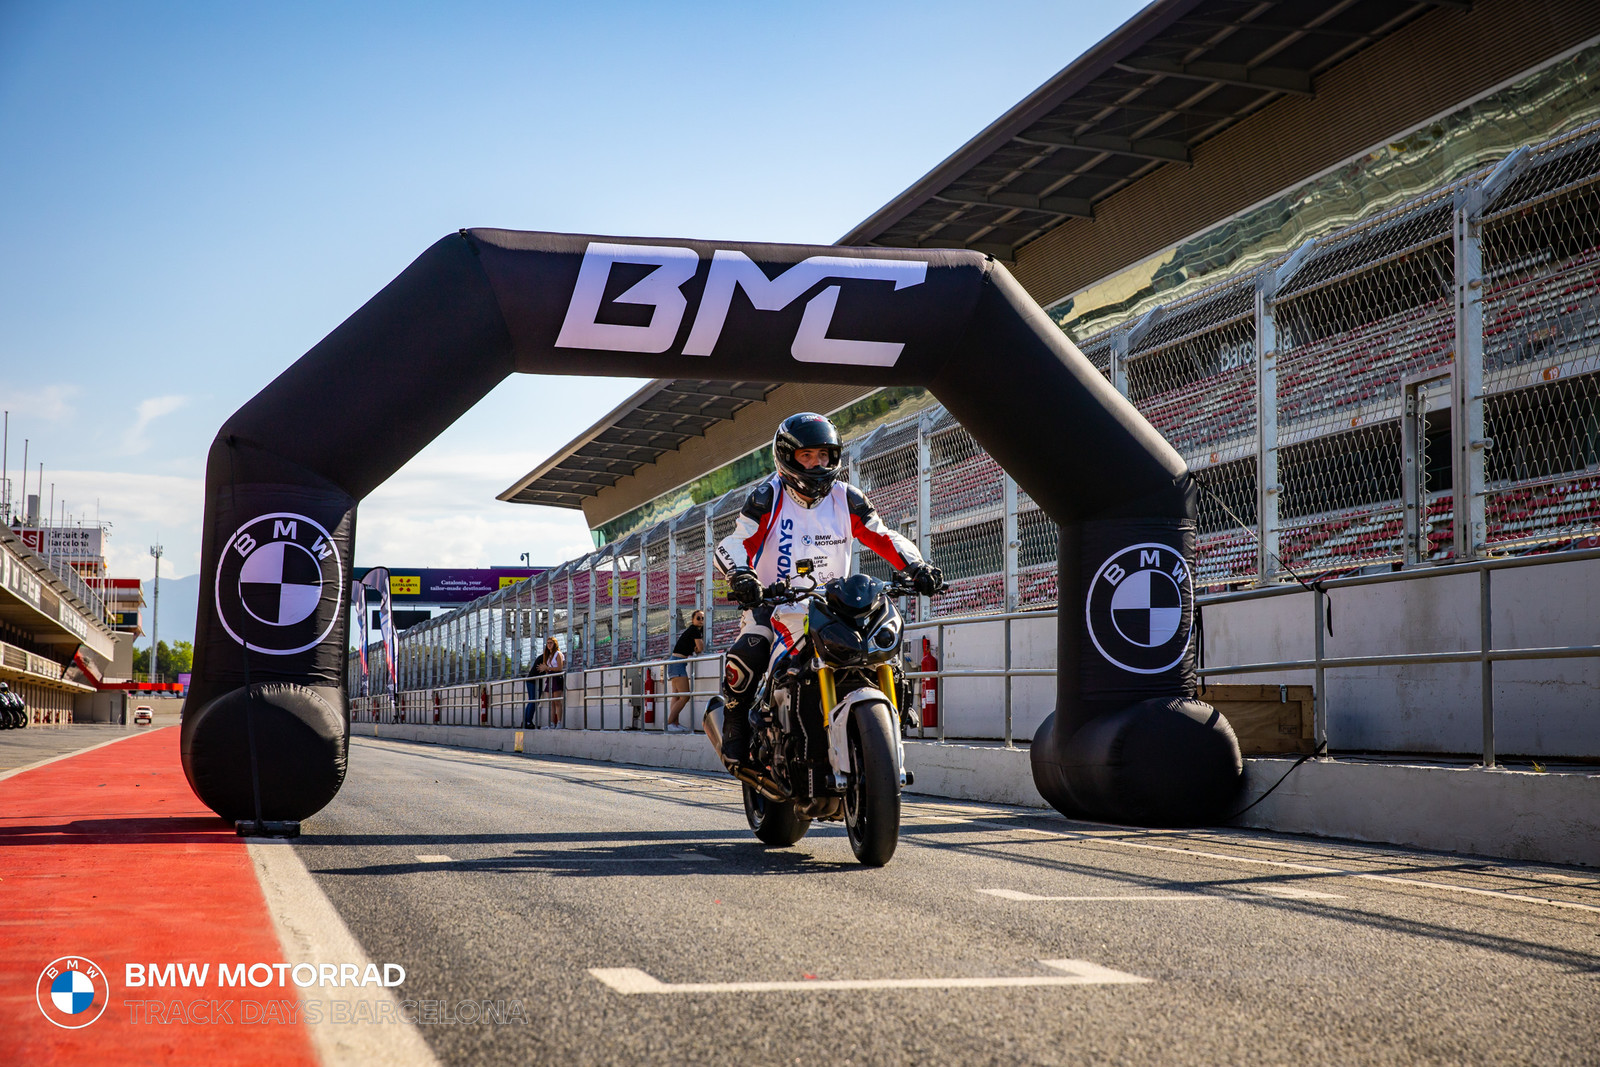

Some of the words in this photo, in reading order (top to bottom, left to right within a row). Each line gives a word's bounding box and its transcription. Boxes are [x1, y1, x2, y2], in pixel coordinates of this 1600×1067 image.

[554, 241, 929, 367] BMC
[233, 520, 333, 561] BMW
[441, 579, 469, 587] Catalonia,
[1102, 550, 1187, 586] BMW
